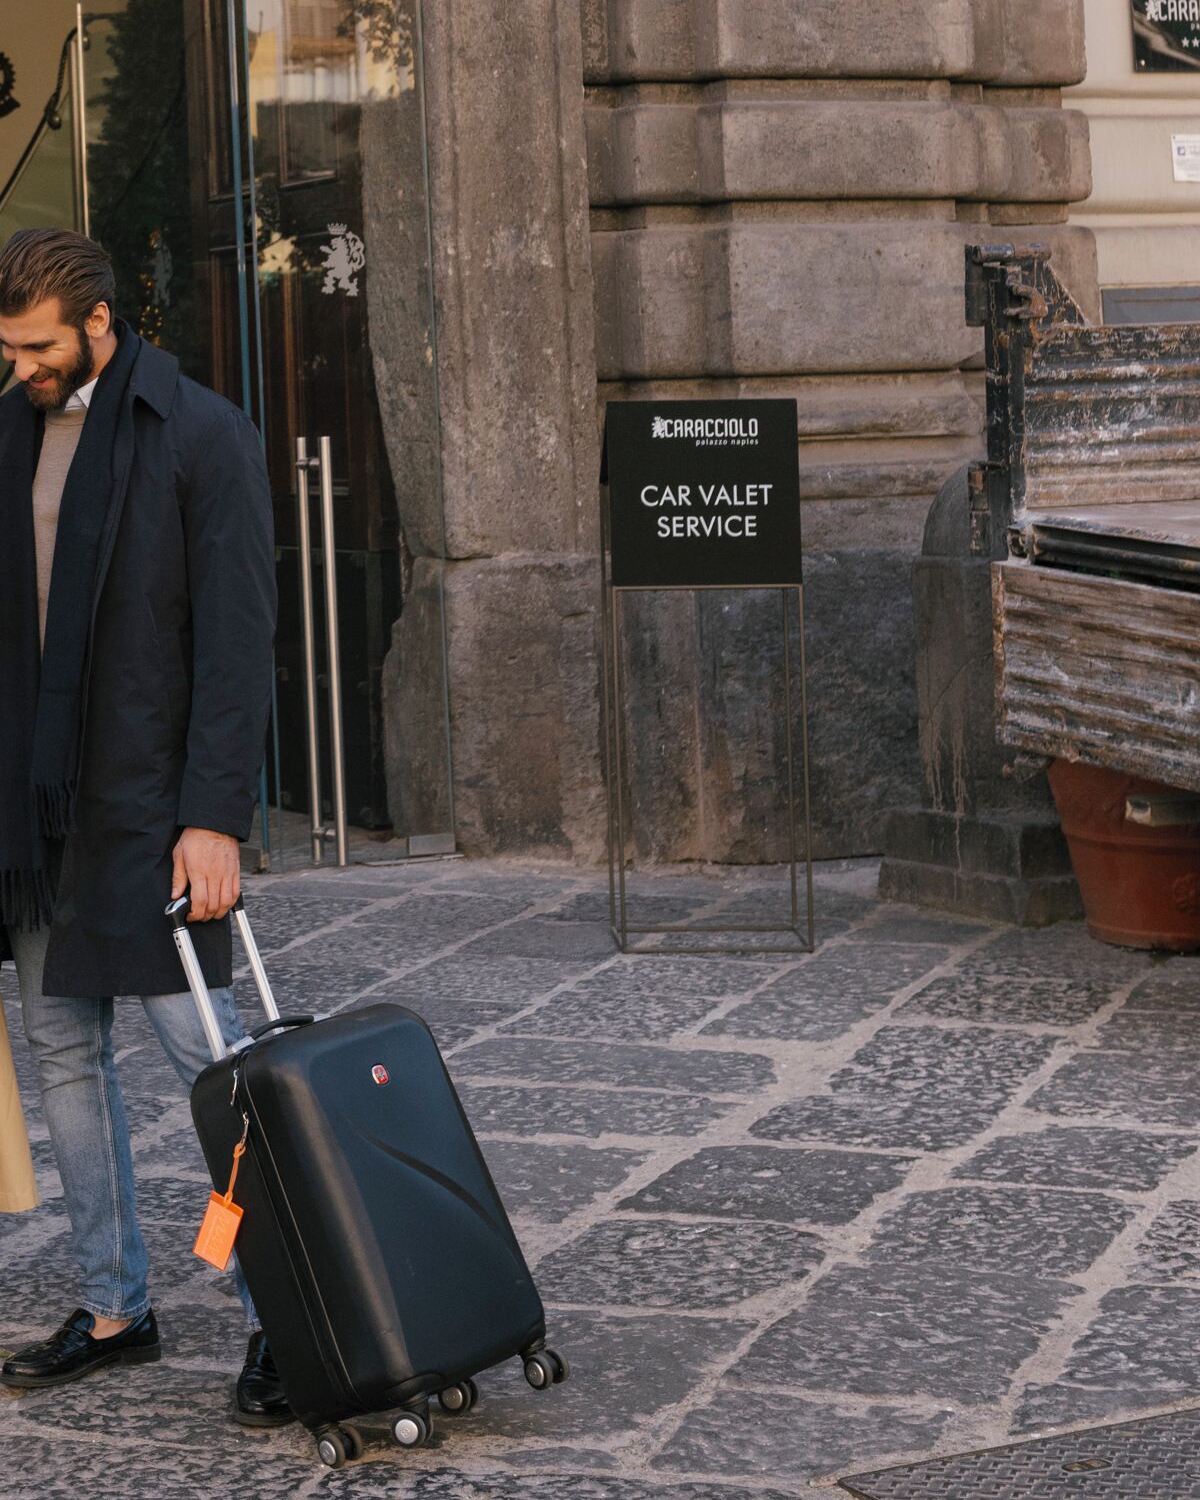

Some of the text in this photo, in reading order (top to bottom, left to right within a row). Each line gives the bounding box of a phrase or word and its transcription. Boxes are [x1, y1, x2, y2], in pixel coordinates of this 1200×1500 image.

[664, 418, 759, 438] CARACCIOLO
[695, 437, 759, 447] palazzo naples
[640, 484, 773, 507] CAR VALET
[657, 515, 757, 538] SERVICE
